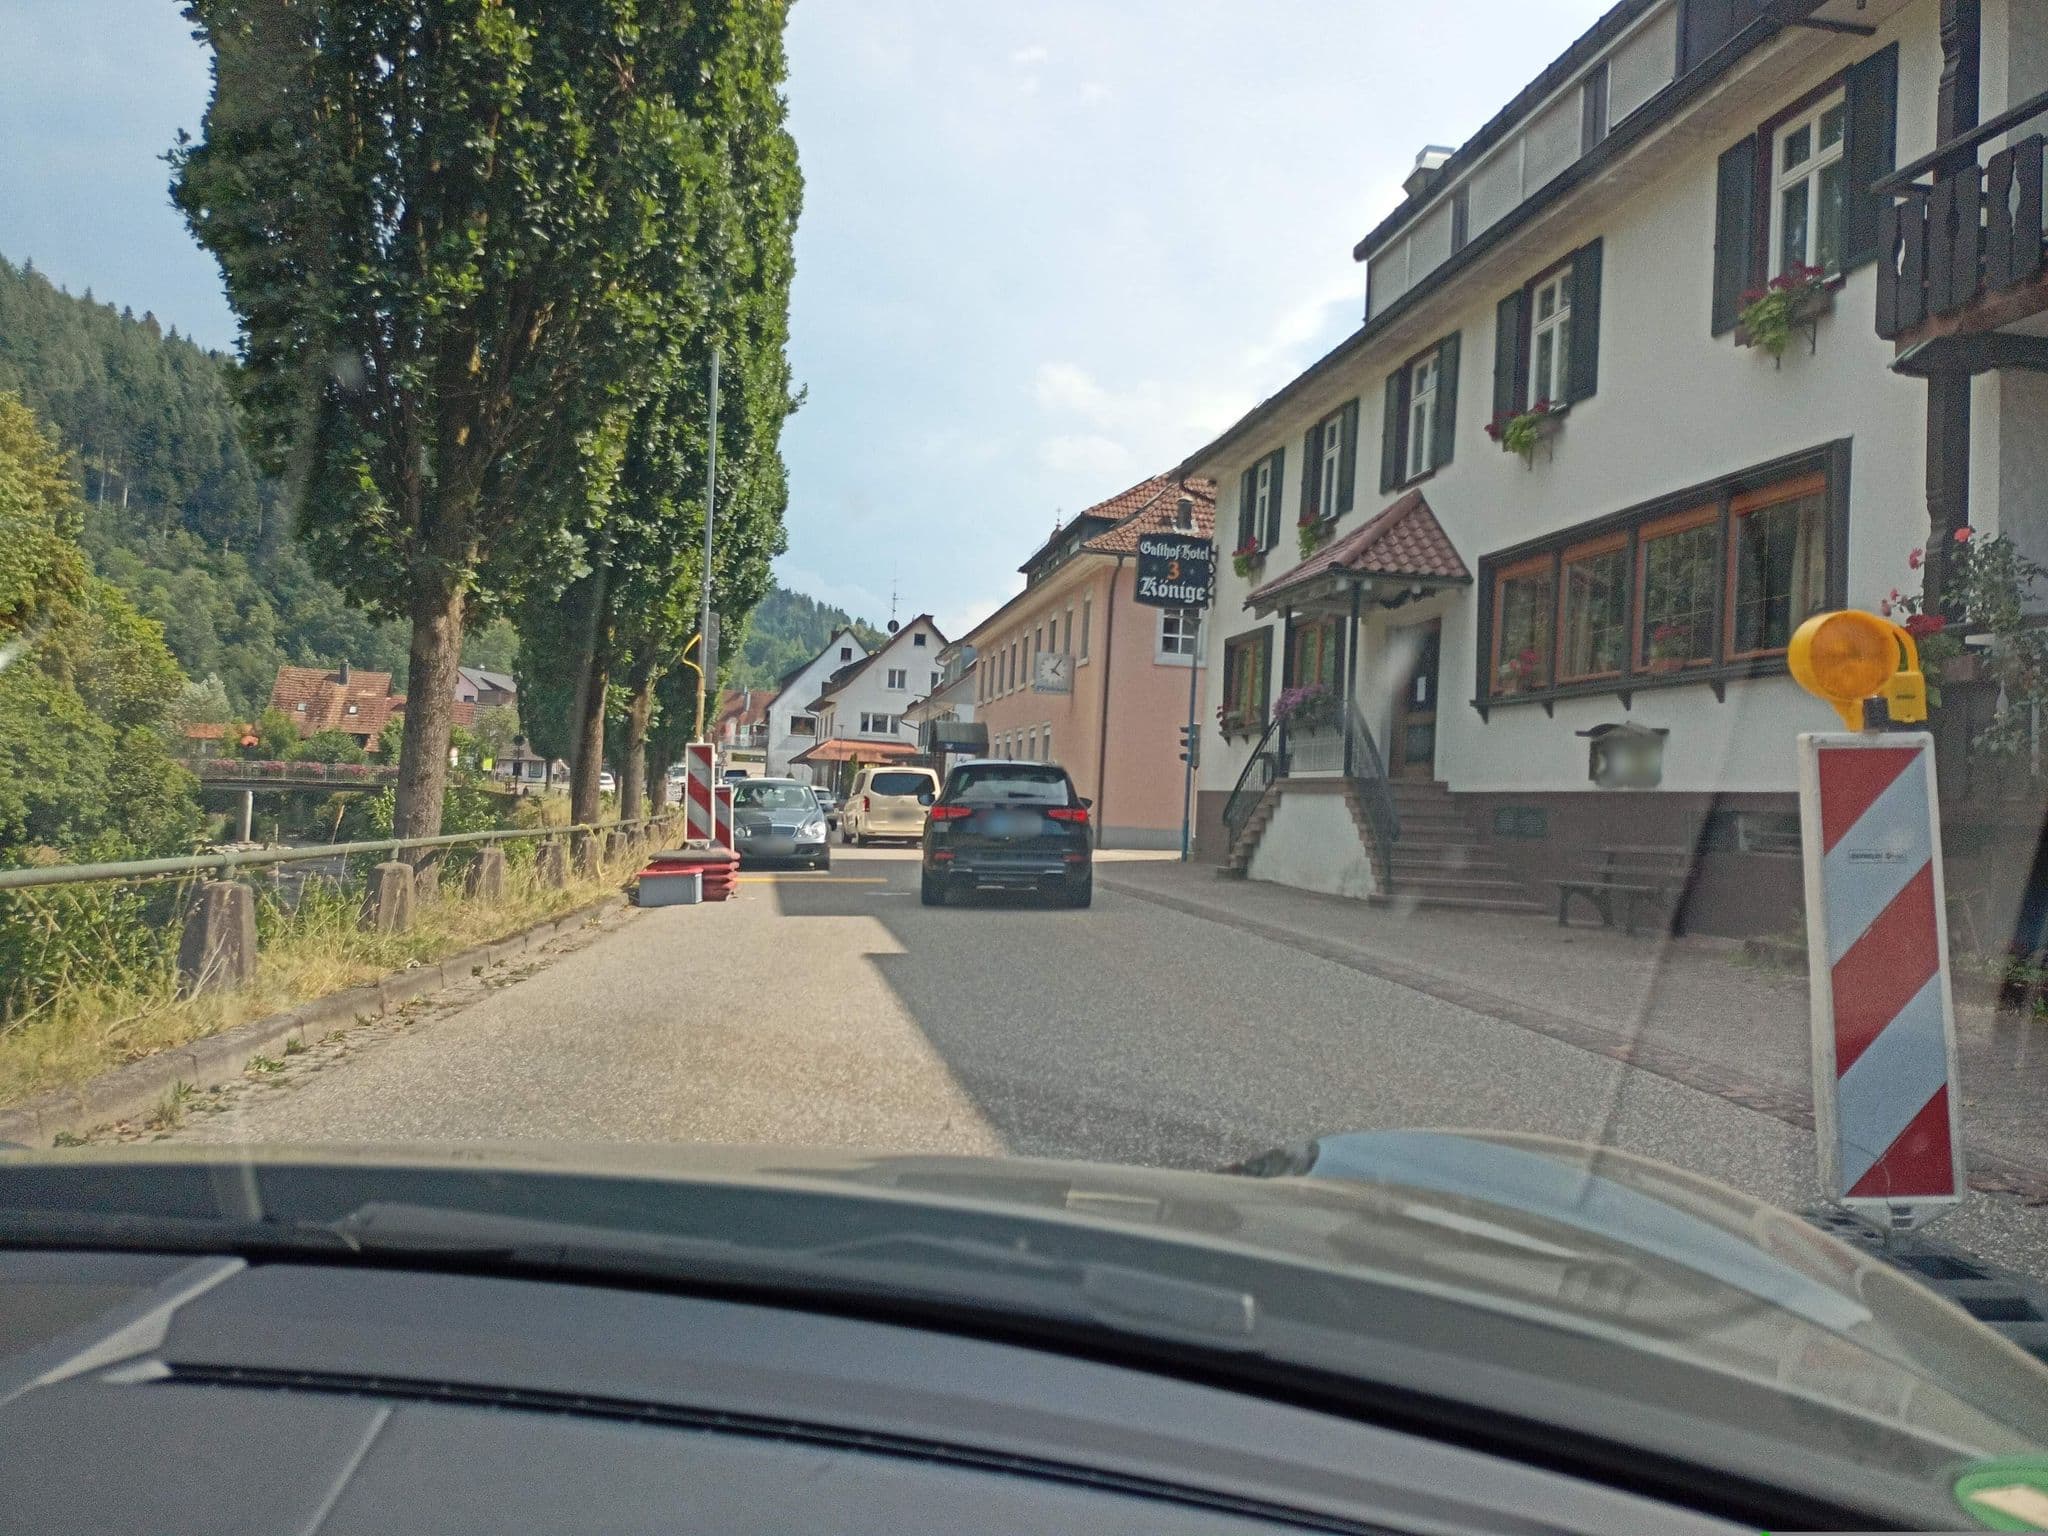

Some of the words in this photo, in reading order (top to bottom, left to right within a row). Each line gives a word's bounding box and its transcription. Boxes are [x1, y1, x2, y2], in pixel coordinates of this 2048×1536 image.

[1181, 544, 1209, 560] Hotel
[1167, 560, 1181, 580] 3
[1139, 576, 1206, 603] Könige
